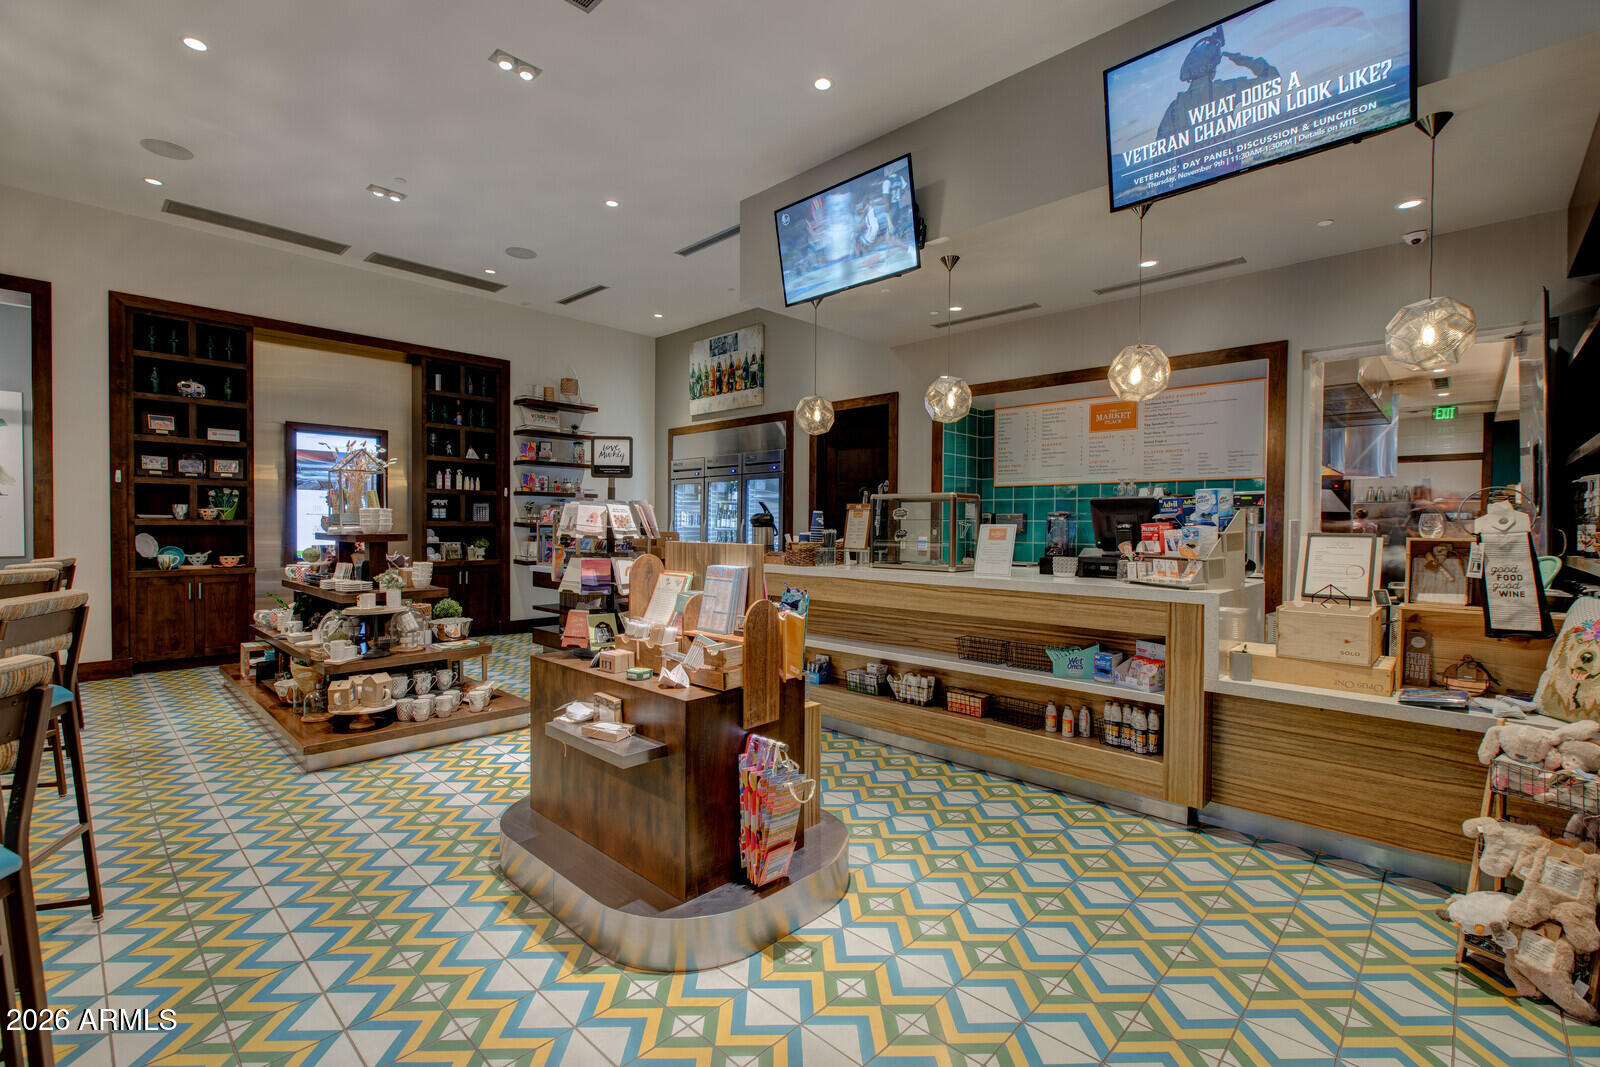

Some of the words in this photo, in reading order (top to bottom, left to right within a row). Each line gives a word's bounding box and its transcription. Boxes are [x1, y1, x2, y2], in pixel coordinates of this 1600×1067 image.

[1188, 93, 1237, 126] WHAT
[1241, 76, 1282, 107] DOES
[1286, 70, 1302, 92] A
[1122, 129, 1190, 167] VETERAN
[1194, 97, 1281, 143] CHAMPION
[1286, 79, 1333, 113] LOOK
[1338, 58, 1393, 95] LIKE?
[1182, 157, 1201, 170] DAY
[1203, 148, 1234, 164] PANEL
[1236, 126, 1299, 153] DISCUSSION
[1301, 123, 1310, 132] &
[1313, 100, 1378, 128] LUNCHEON
[1178, 163, 1213, 180] November
[1213, 158, 1226, 168] 9th
[1298, 127, 1326, 142] Details
[1327, 125, 1338, 133] on
[1339, 116, 1359, 129] MTL
[1096, 411, 1131, 421] MARKET
[1435, 407, 1456, 420] EXIT
[1162, 500, 1178, 508] Advil
[1490, 566, 1519, 576] good
[1492, 581, 1521, 592] good
[1498, 590, 1526, 598] WINE
[1068, 656, 1084, 665] Wet
[1066, 663, 1084, 671] Ones
